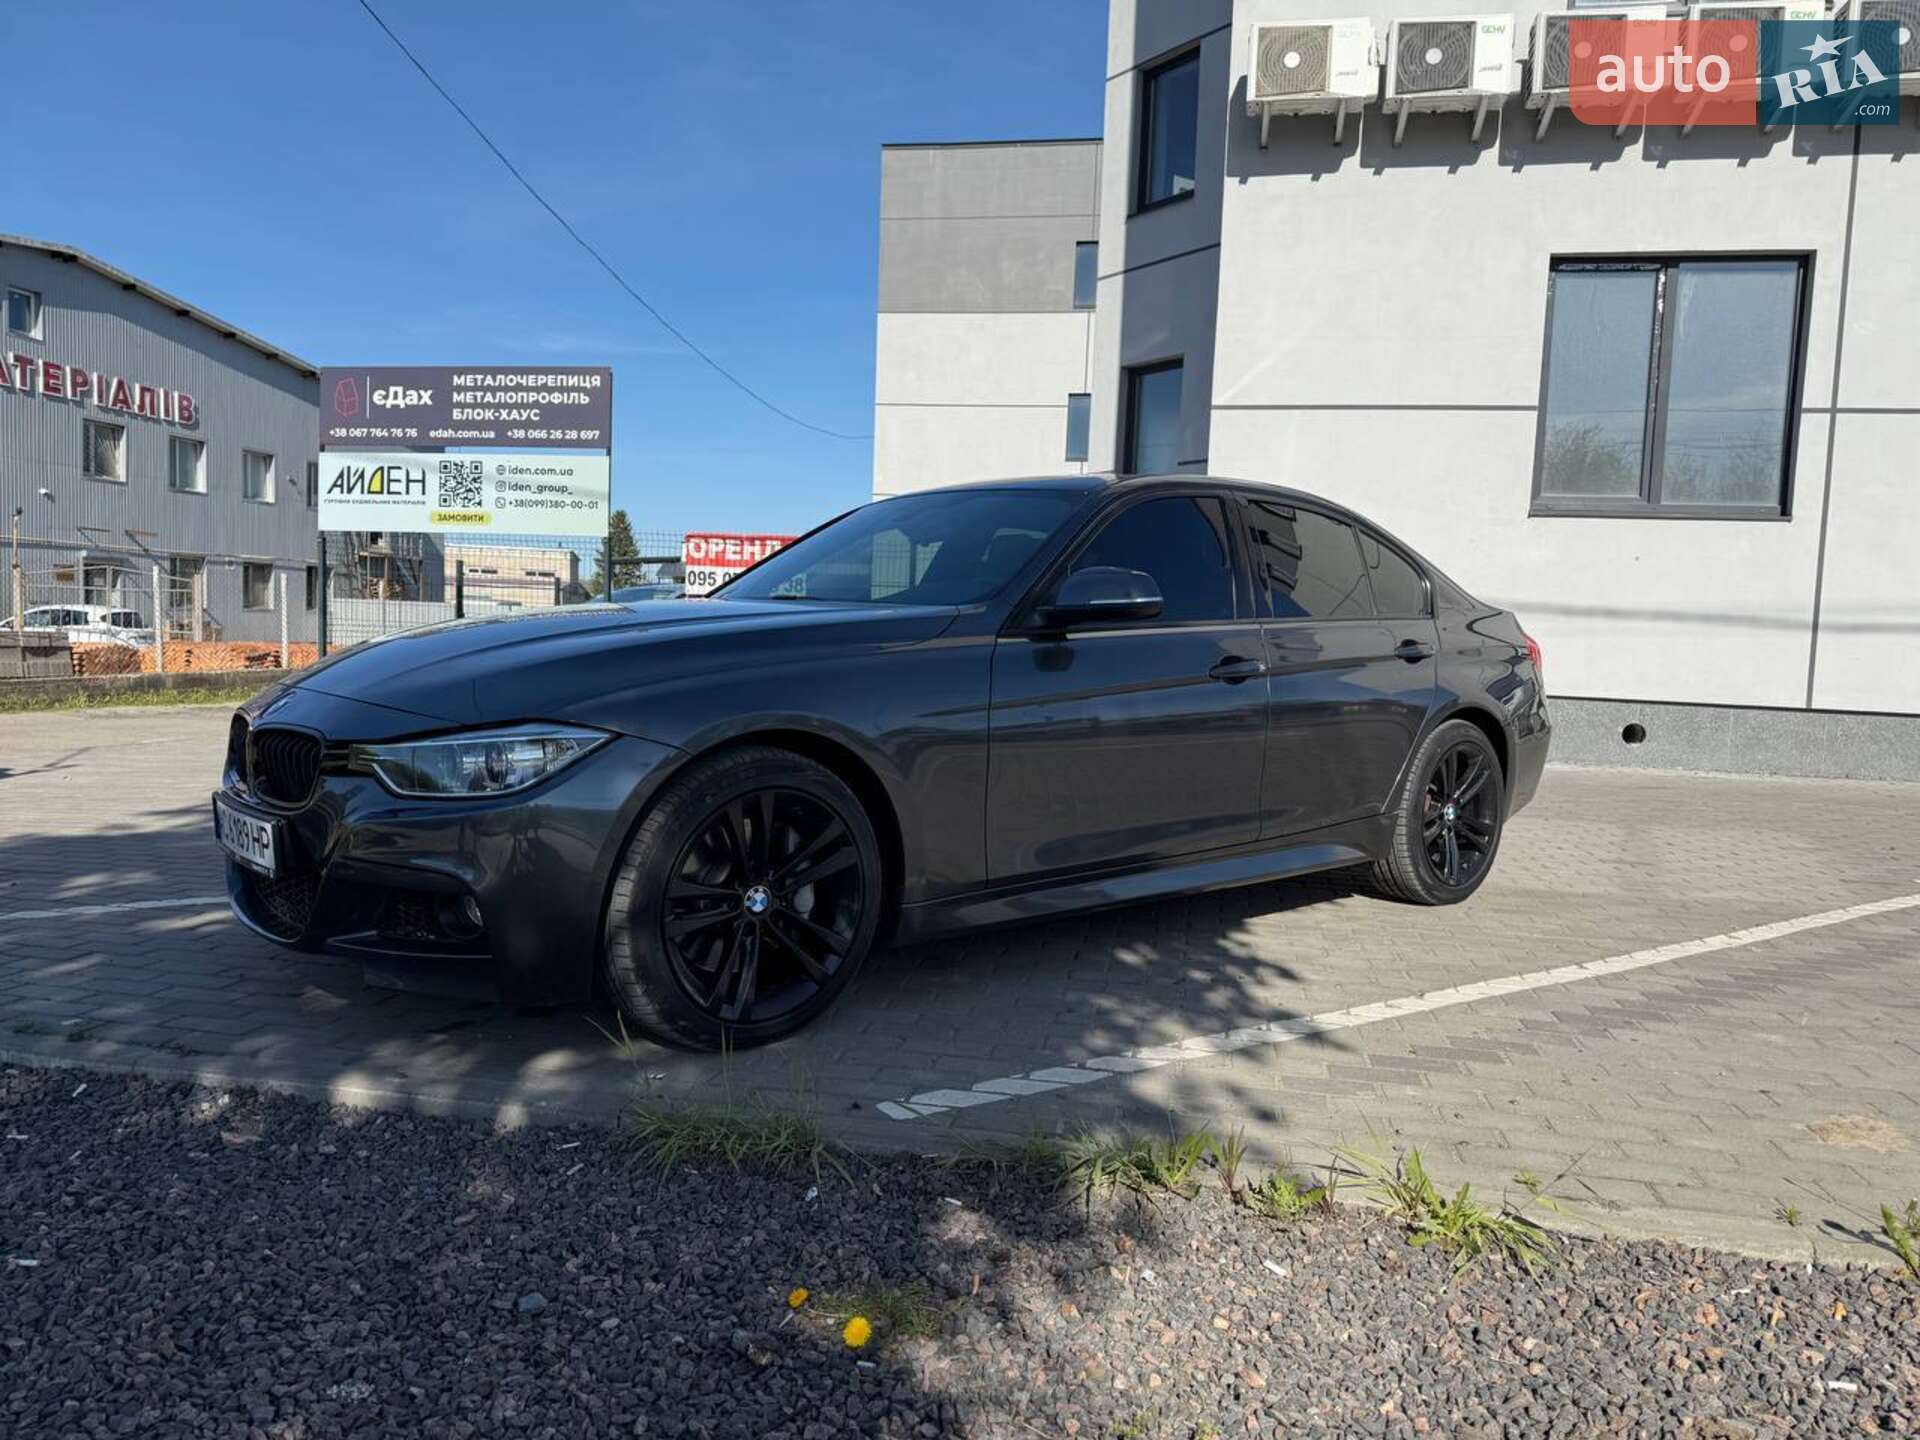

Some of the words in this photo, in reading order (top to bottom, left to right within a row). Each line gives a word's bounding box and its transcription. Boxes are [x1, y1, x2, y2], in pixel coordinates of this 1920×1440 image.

[452, 374, 601, 389] МЕТАЛОЧЕРЕПИЦЯ
[372, 385, 433, 409] єДах
[452, 391, 590, 404] МЕТАЛОПРОФІЛЬ
[452, 408, 541, 421] БЛОК-ХАУС
[329, 428, 347, 438] +38
[349, 428, 367, 438] 067
[370, 428, 389, 438] 764
[391, 428, 403, 438] 76
[405, 428, 418, 438] 76
[429, 428, 496, 439] edah.com.ua
[507, 429, 525, 439] +38
[527, 429, 548, 440] 066
[550, 429, 562, 440] 26
[565, 430, 577, 440] 28
[580, 430, 600, 440] 697
[508, 465, 574, 477] iden.com.ua
[326, 465, 427, 496] АЙДЕН
[508, 482, 574, 495] iden_group_
[437, 513, 485, 523] ЗАМОВИТИ
[688, 570, 717, 586] 095
